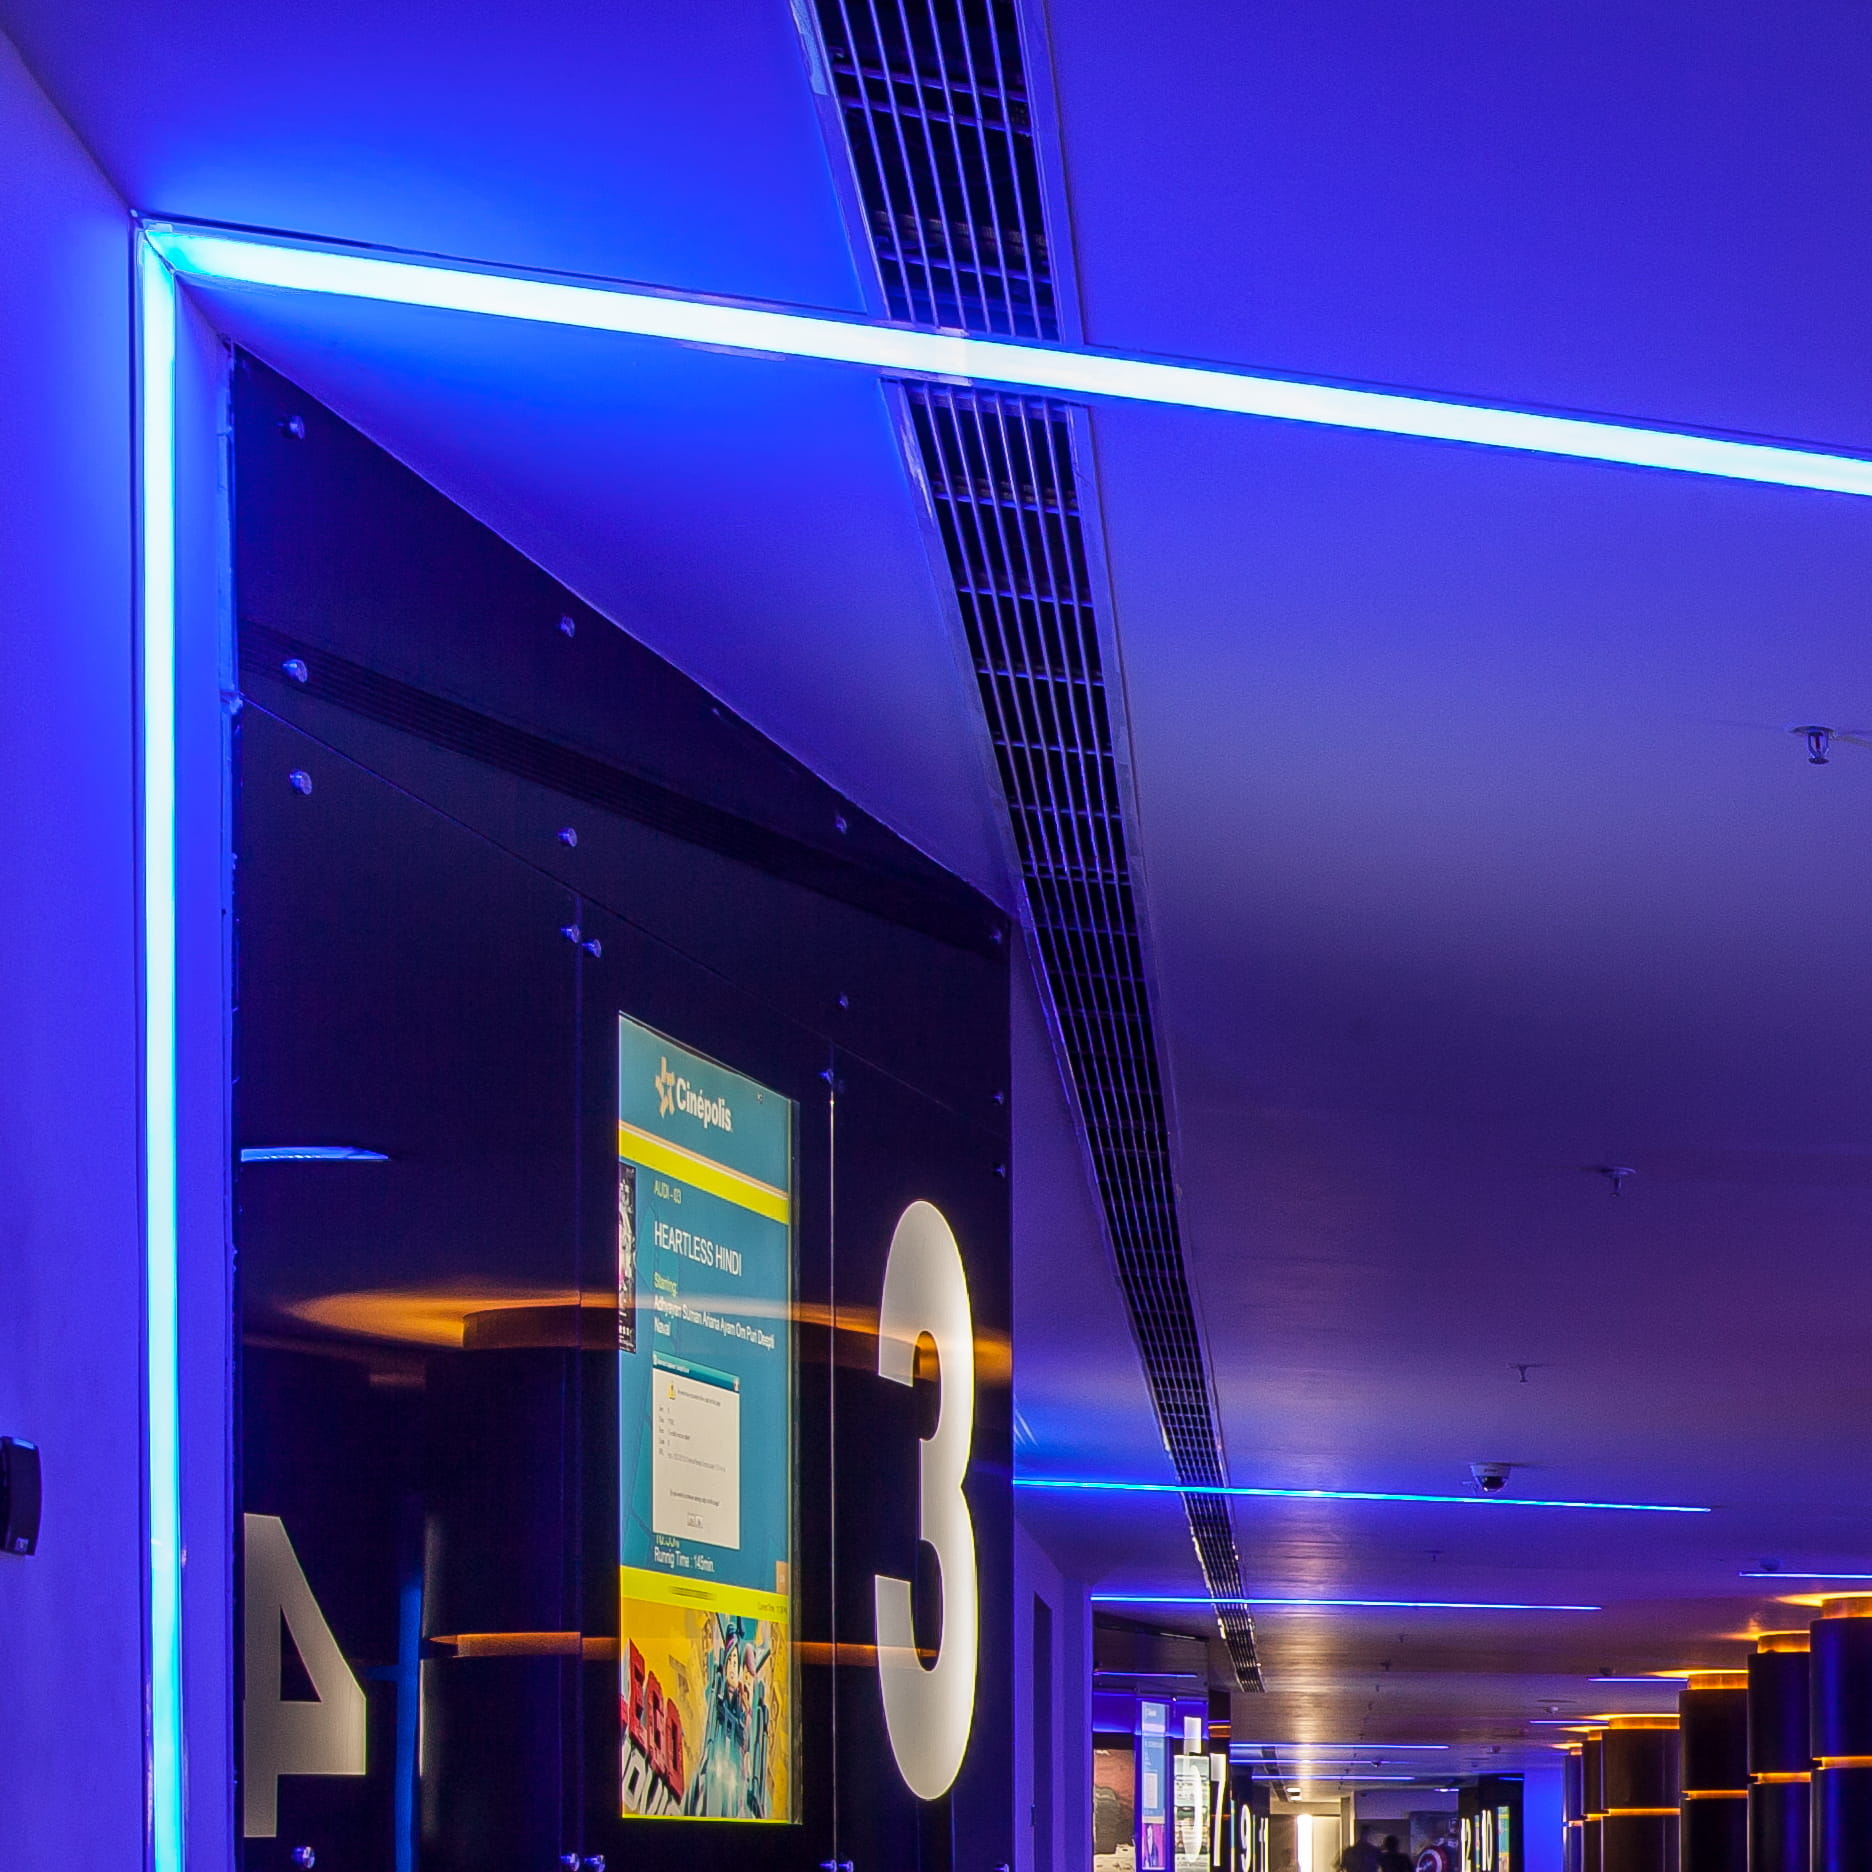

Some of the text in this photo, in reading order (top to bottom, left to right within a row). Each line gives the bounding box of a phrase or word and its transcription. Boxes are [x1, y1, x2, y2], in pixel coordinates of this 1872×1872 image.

[676, 1077, 732, 1132] Cinépolis
[654, 1180, 669, 1199] AUDI
[654, 1221, 742, 1277] HEARTLESS HINDI
[875, 1201, 978, 1800] 3
[1210, 1753, 1227, 1867] 7
[1482, 1810, 1492, 1872] 10
